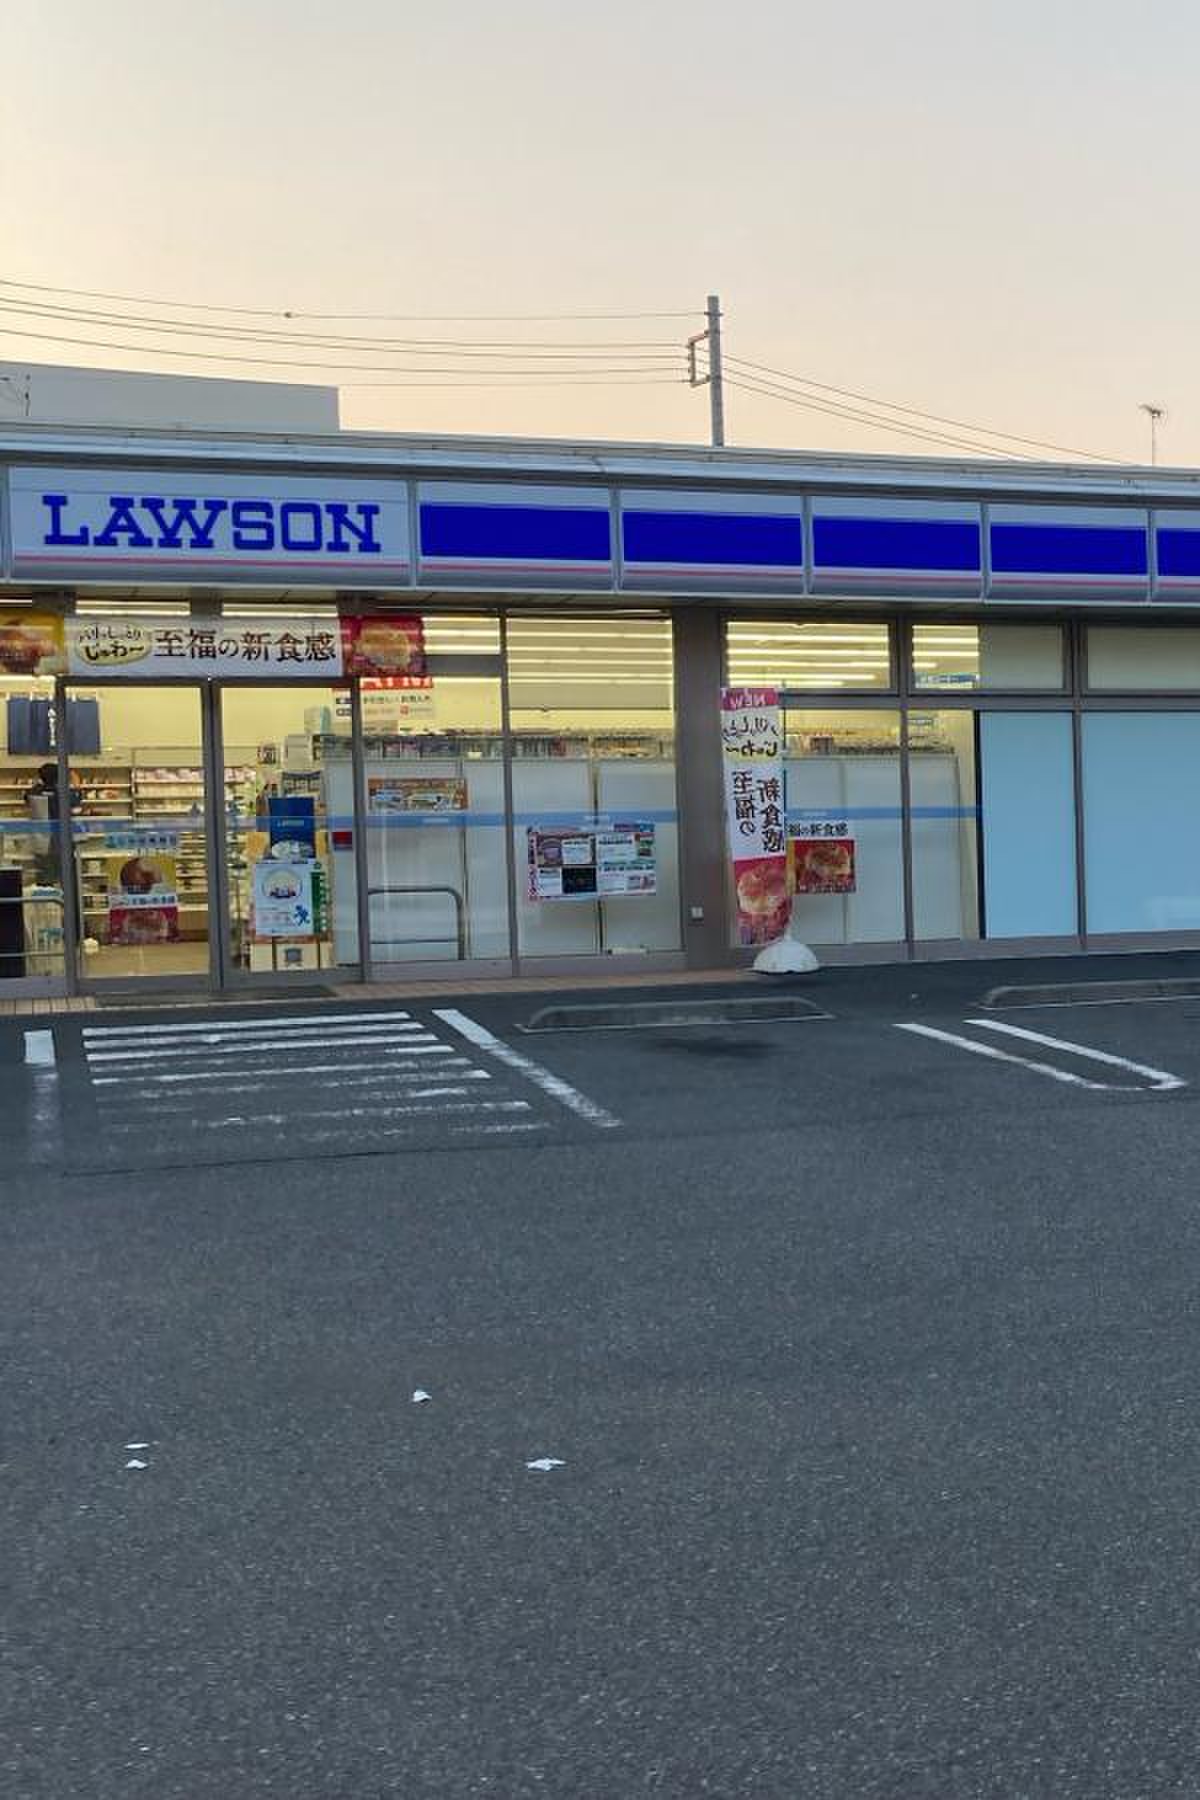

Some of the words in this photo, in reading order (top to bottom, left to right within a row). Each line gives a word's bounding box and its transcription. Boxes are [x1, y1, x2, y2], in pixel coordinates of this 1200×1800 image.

[42, 495, 381, 552] LAWSON
[154, 628, 337, 662] 至福の新食感
